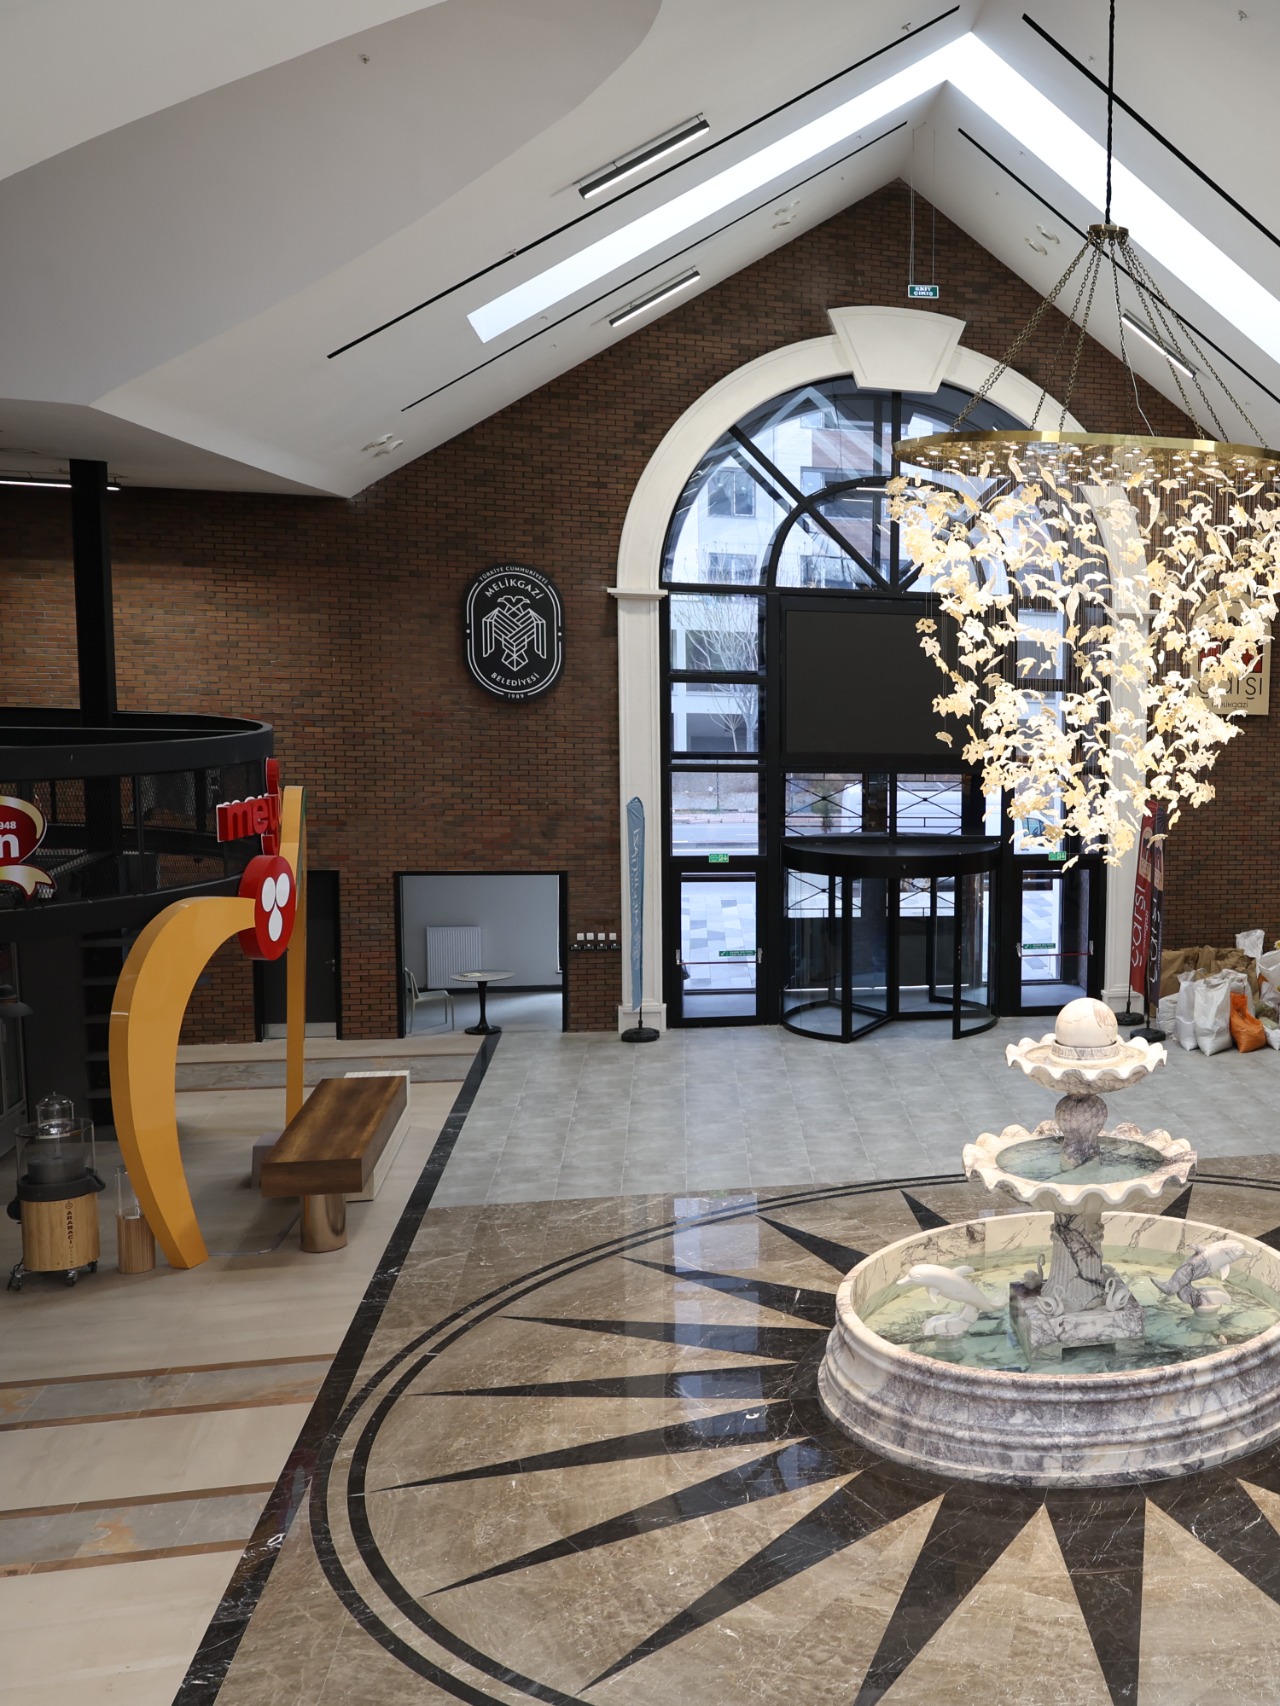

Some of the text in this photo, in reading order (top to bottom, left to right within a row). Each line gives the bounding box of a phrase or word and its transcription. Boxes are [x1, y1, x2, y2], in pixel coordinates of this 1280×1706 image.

[479, 565, 549, 585] TÜRKİYE CUMHURİYETİ
[484, 577, 545, 599] MELİKGAZİ
